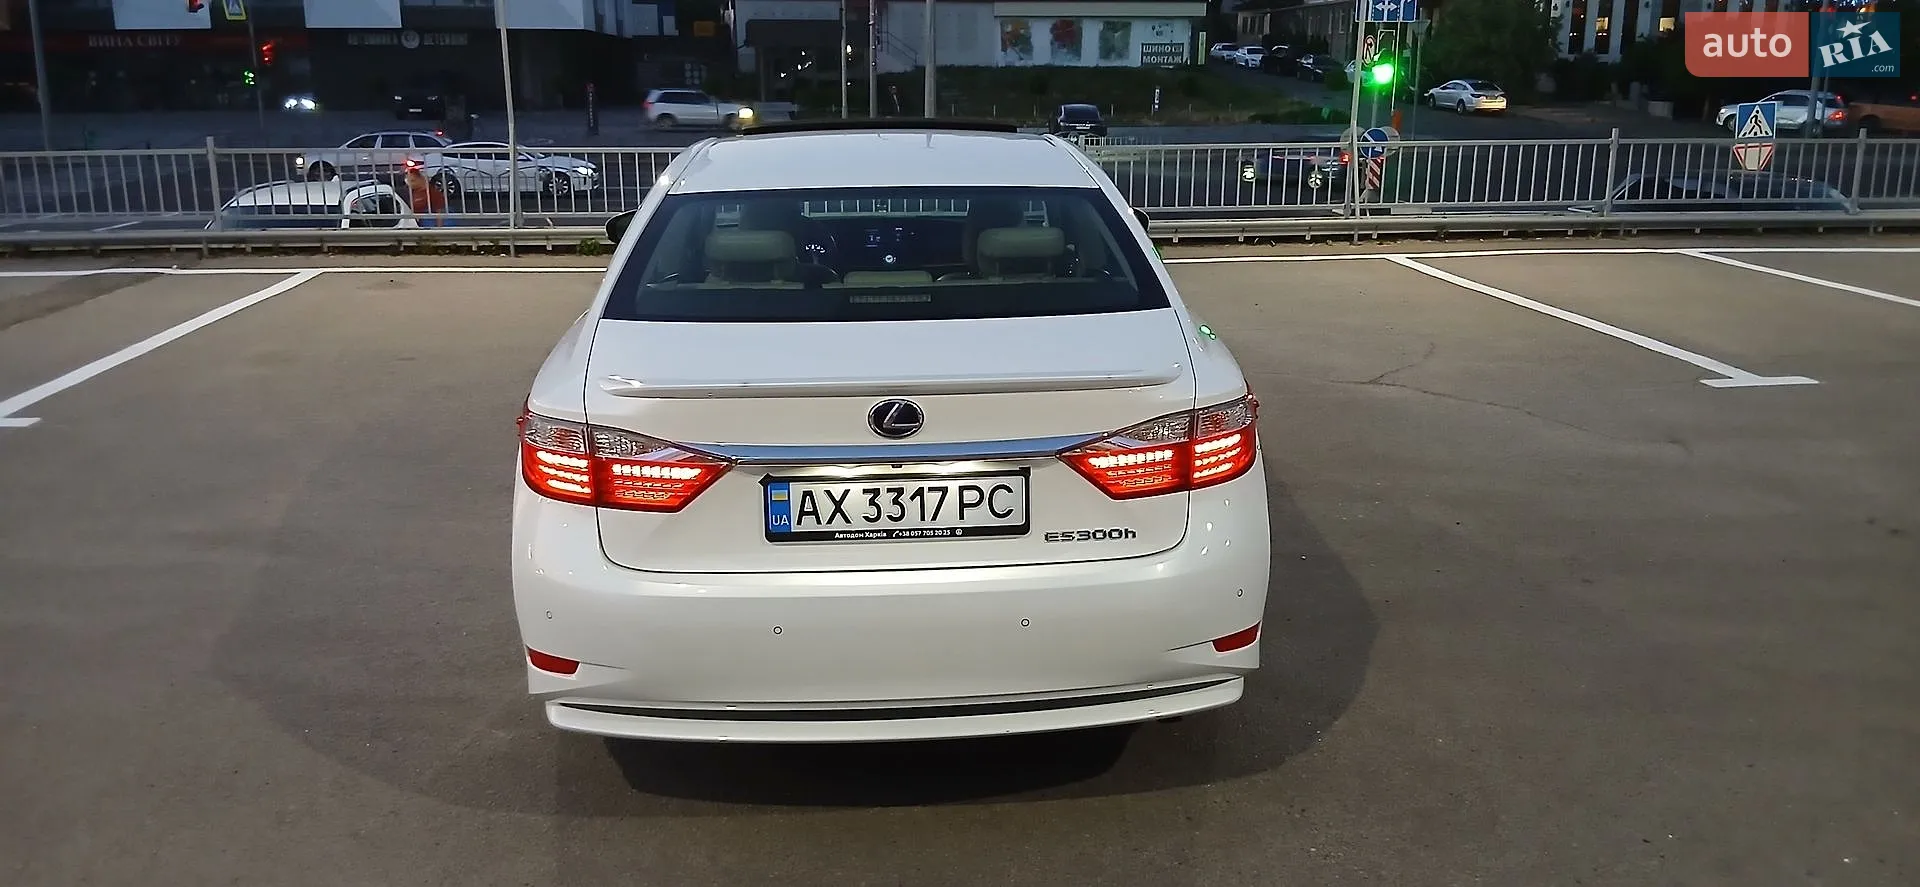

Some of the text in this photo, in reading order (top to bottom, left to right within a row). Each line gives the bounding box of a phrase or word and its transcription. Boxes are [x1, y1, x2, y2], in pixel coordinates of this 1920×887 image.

[88, 35, 133, 47] ВИНА
[1143, 55, 1182, 64] МОНТАЖ
[796, 483, 1014, 526] AX 3317 PC
[772, 514, 789, 526] UA
[1044, 527, 1137, 543] ES300h
